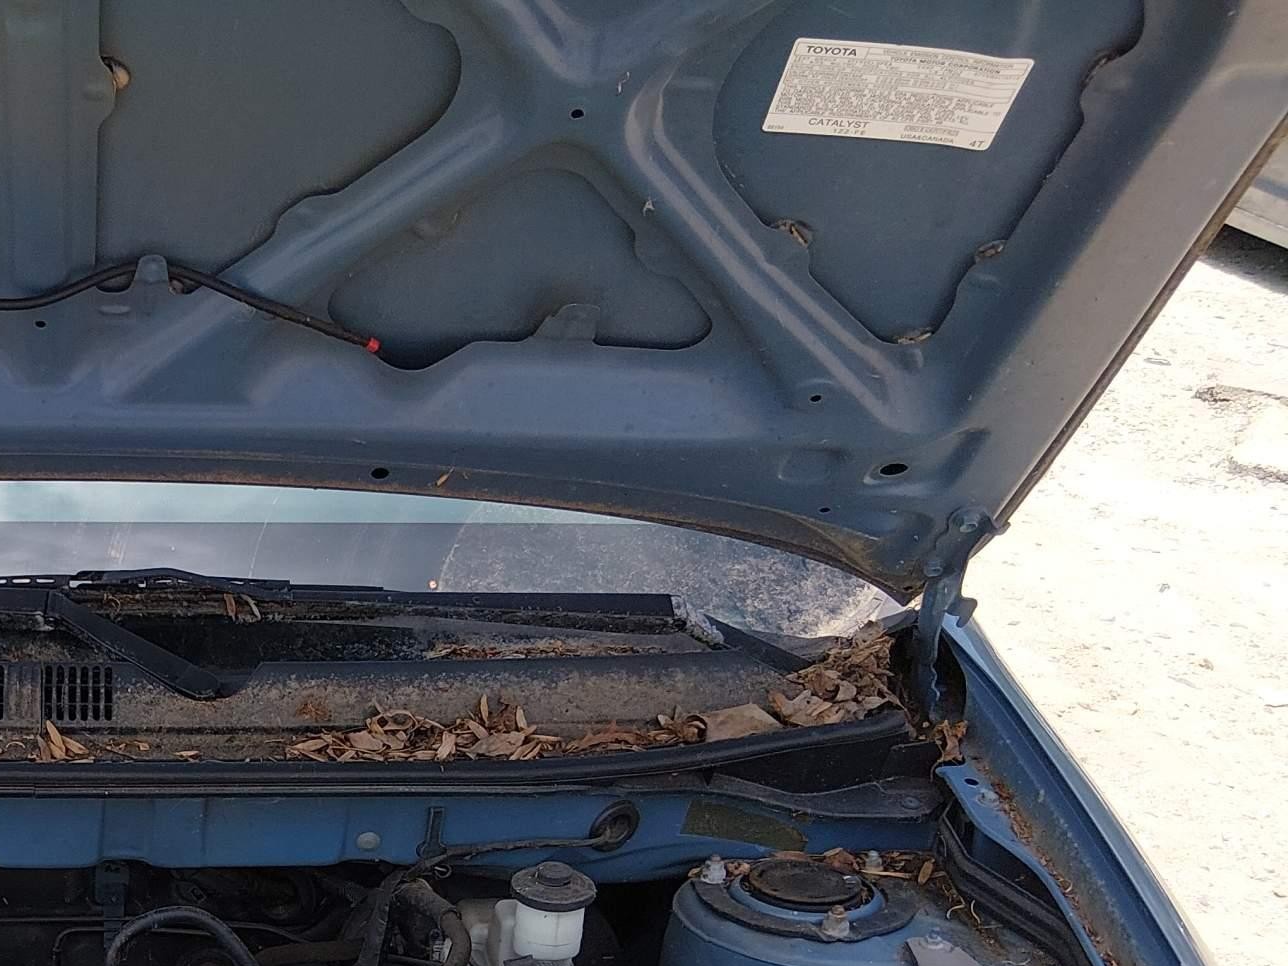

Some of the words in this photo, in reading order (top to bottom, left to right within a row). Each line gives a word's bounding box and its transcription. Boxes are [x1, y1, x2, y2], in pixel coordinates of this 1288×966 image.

[807, 45, 857, 56] TOYOTA
[948, 62, 1001, 74] CORPORATION
[808, 117, 870, 129] CATALYST
